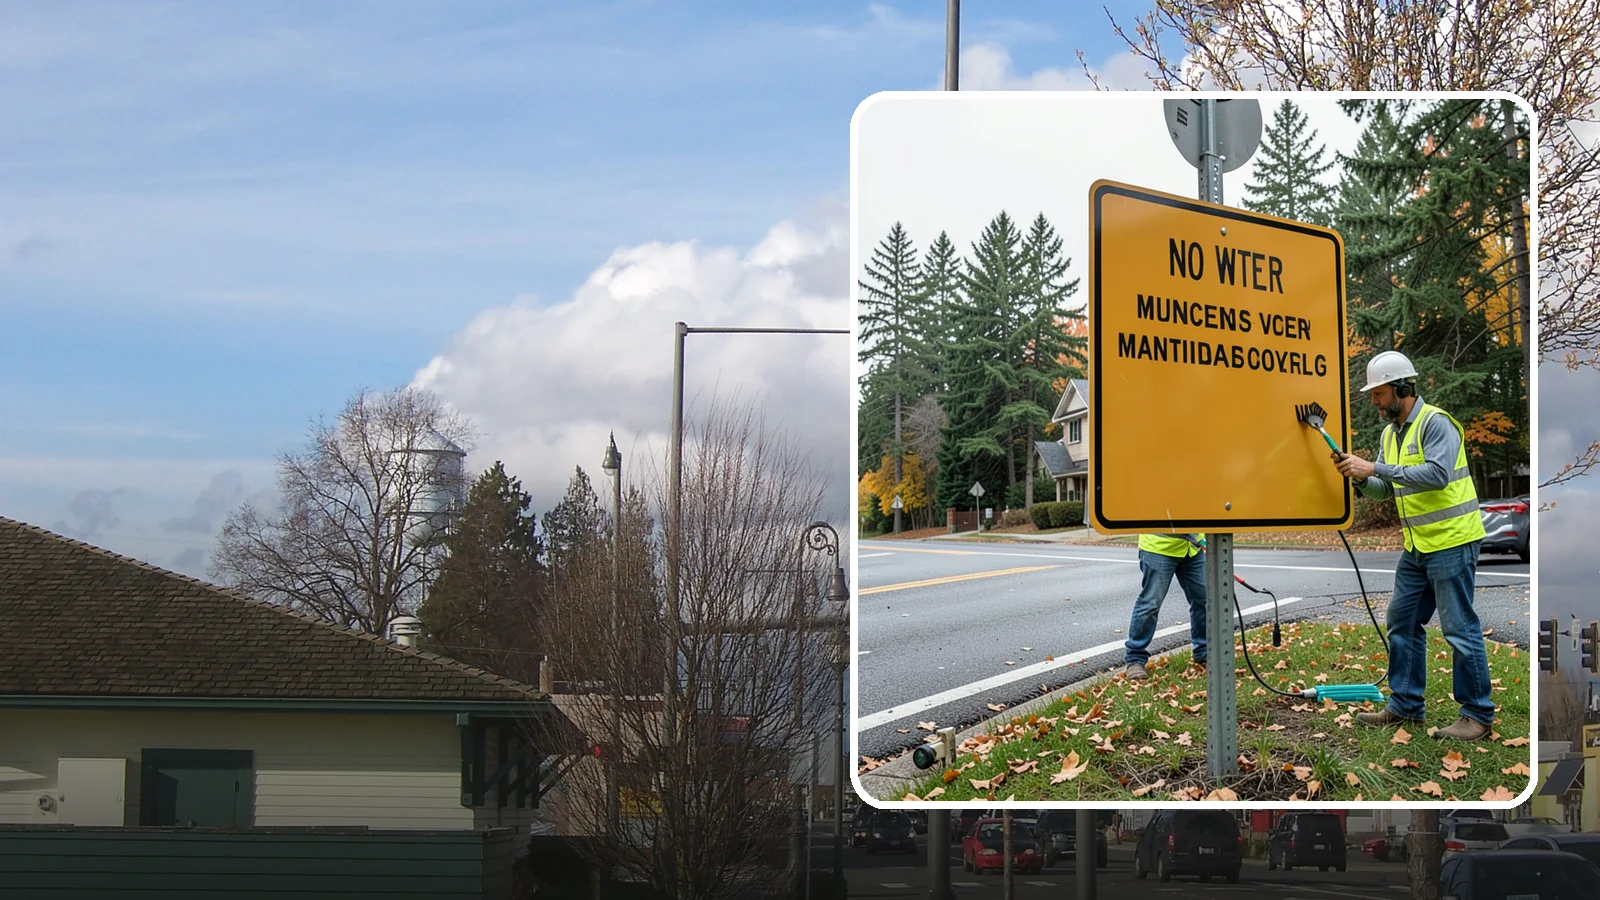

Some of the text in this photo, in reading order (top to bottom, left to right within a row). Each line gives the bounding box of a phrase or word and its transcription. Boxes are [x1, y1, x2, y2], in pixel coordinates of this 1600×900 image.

[1169, 238, 1284, 294] NO WTER
[1137, 294, 1252, 333] MUNCENS
